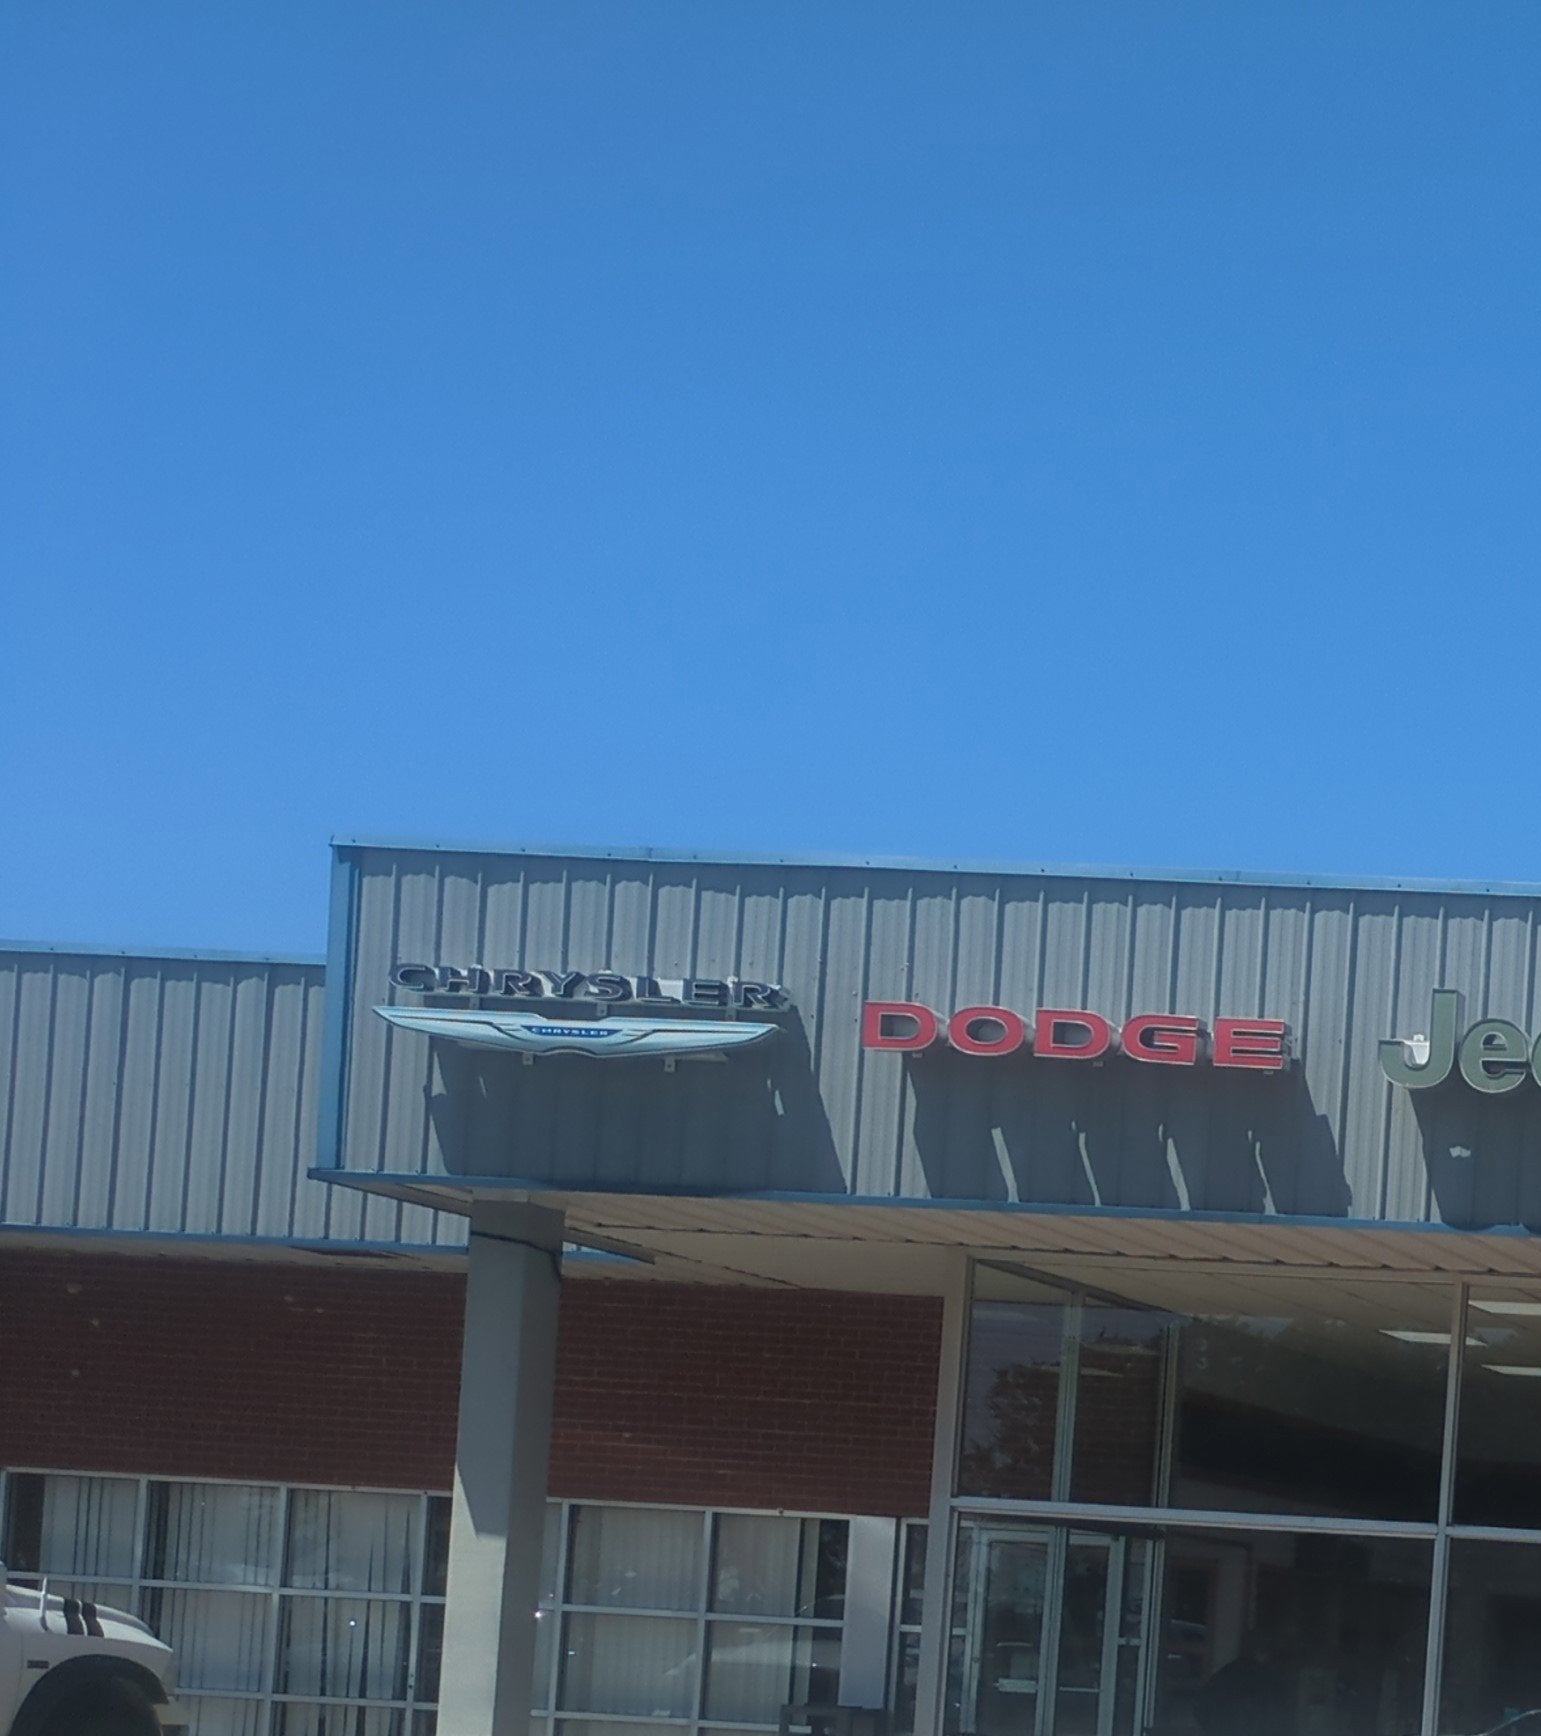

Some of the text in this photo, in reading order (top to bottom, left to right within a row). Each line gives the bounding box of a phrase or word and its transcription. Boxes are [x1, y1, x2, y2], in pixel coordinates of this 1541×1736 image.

[388, 963, 786, 1008] CHRYSLER
[531, 1027, 608, 1036] CHRYSLER
[864, 1001, 1286, 1069] DODGE
